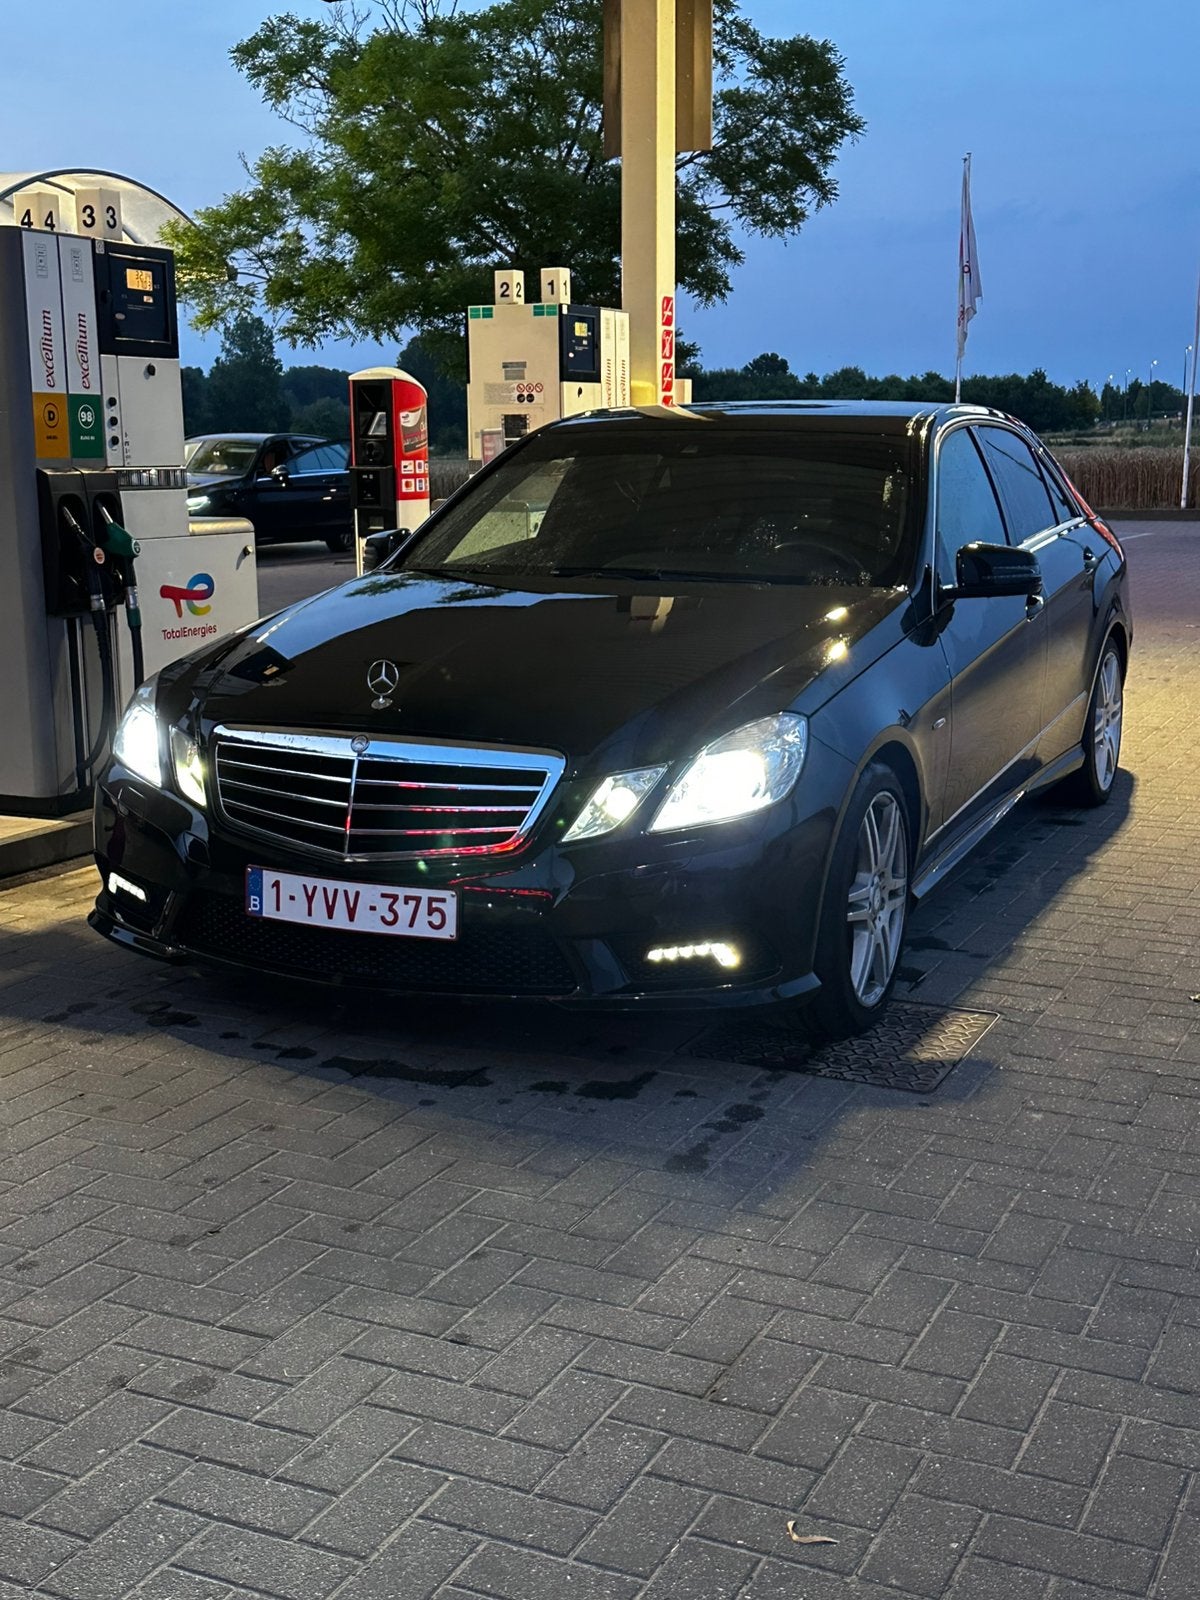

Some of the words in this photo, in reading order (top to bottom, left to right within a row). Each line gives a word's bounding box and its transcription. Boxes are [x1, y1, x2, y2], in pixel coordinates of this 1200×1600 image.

[21, 209, 33, 228] 4
[44, 210, 56, 231] 4
[82, 205, 96, 228] 3
[106, 205, 117, 229] 3
[500, 282, 510, 297] 2
[516, 282, 522, 297] 2
[547, 280, 555, 295] 1
[563, 280, 568, 295] 1
[40, 309, 55, 389] excellium
[75, 313, 91, 390] excellium
[47, 410, 55, 422] D
[80, 411, 93, 423] 98
[161, 624, 218, 641] TotalEnergies
[250, 896, 260, 911] B
[270, 879, 448, 931] 1-YVV-375
